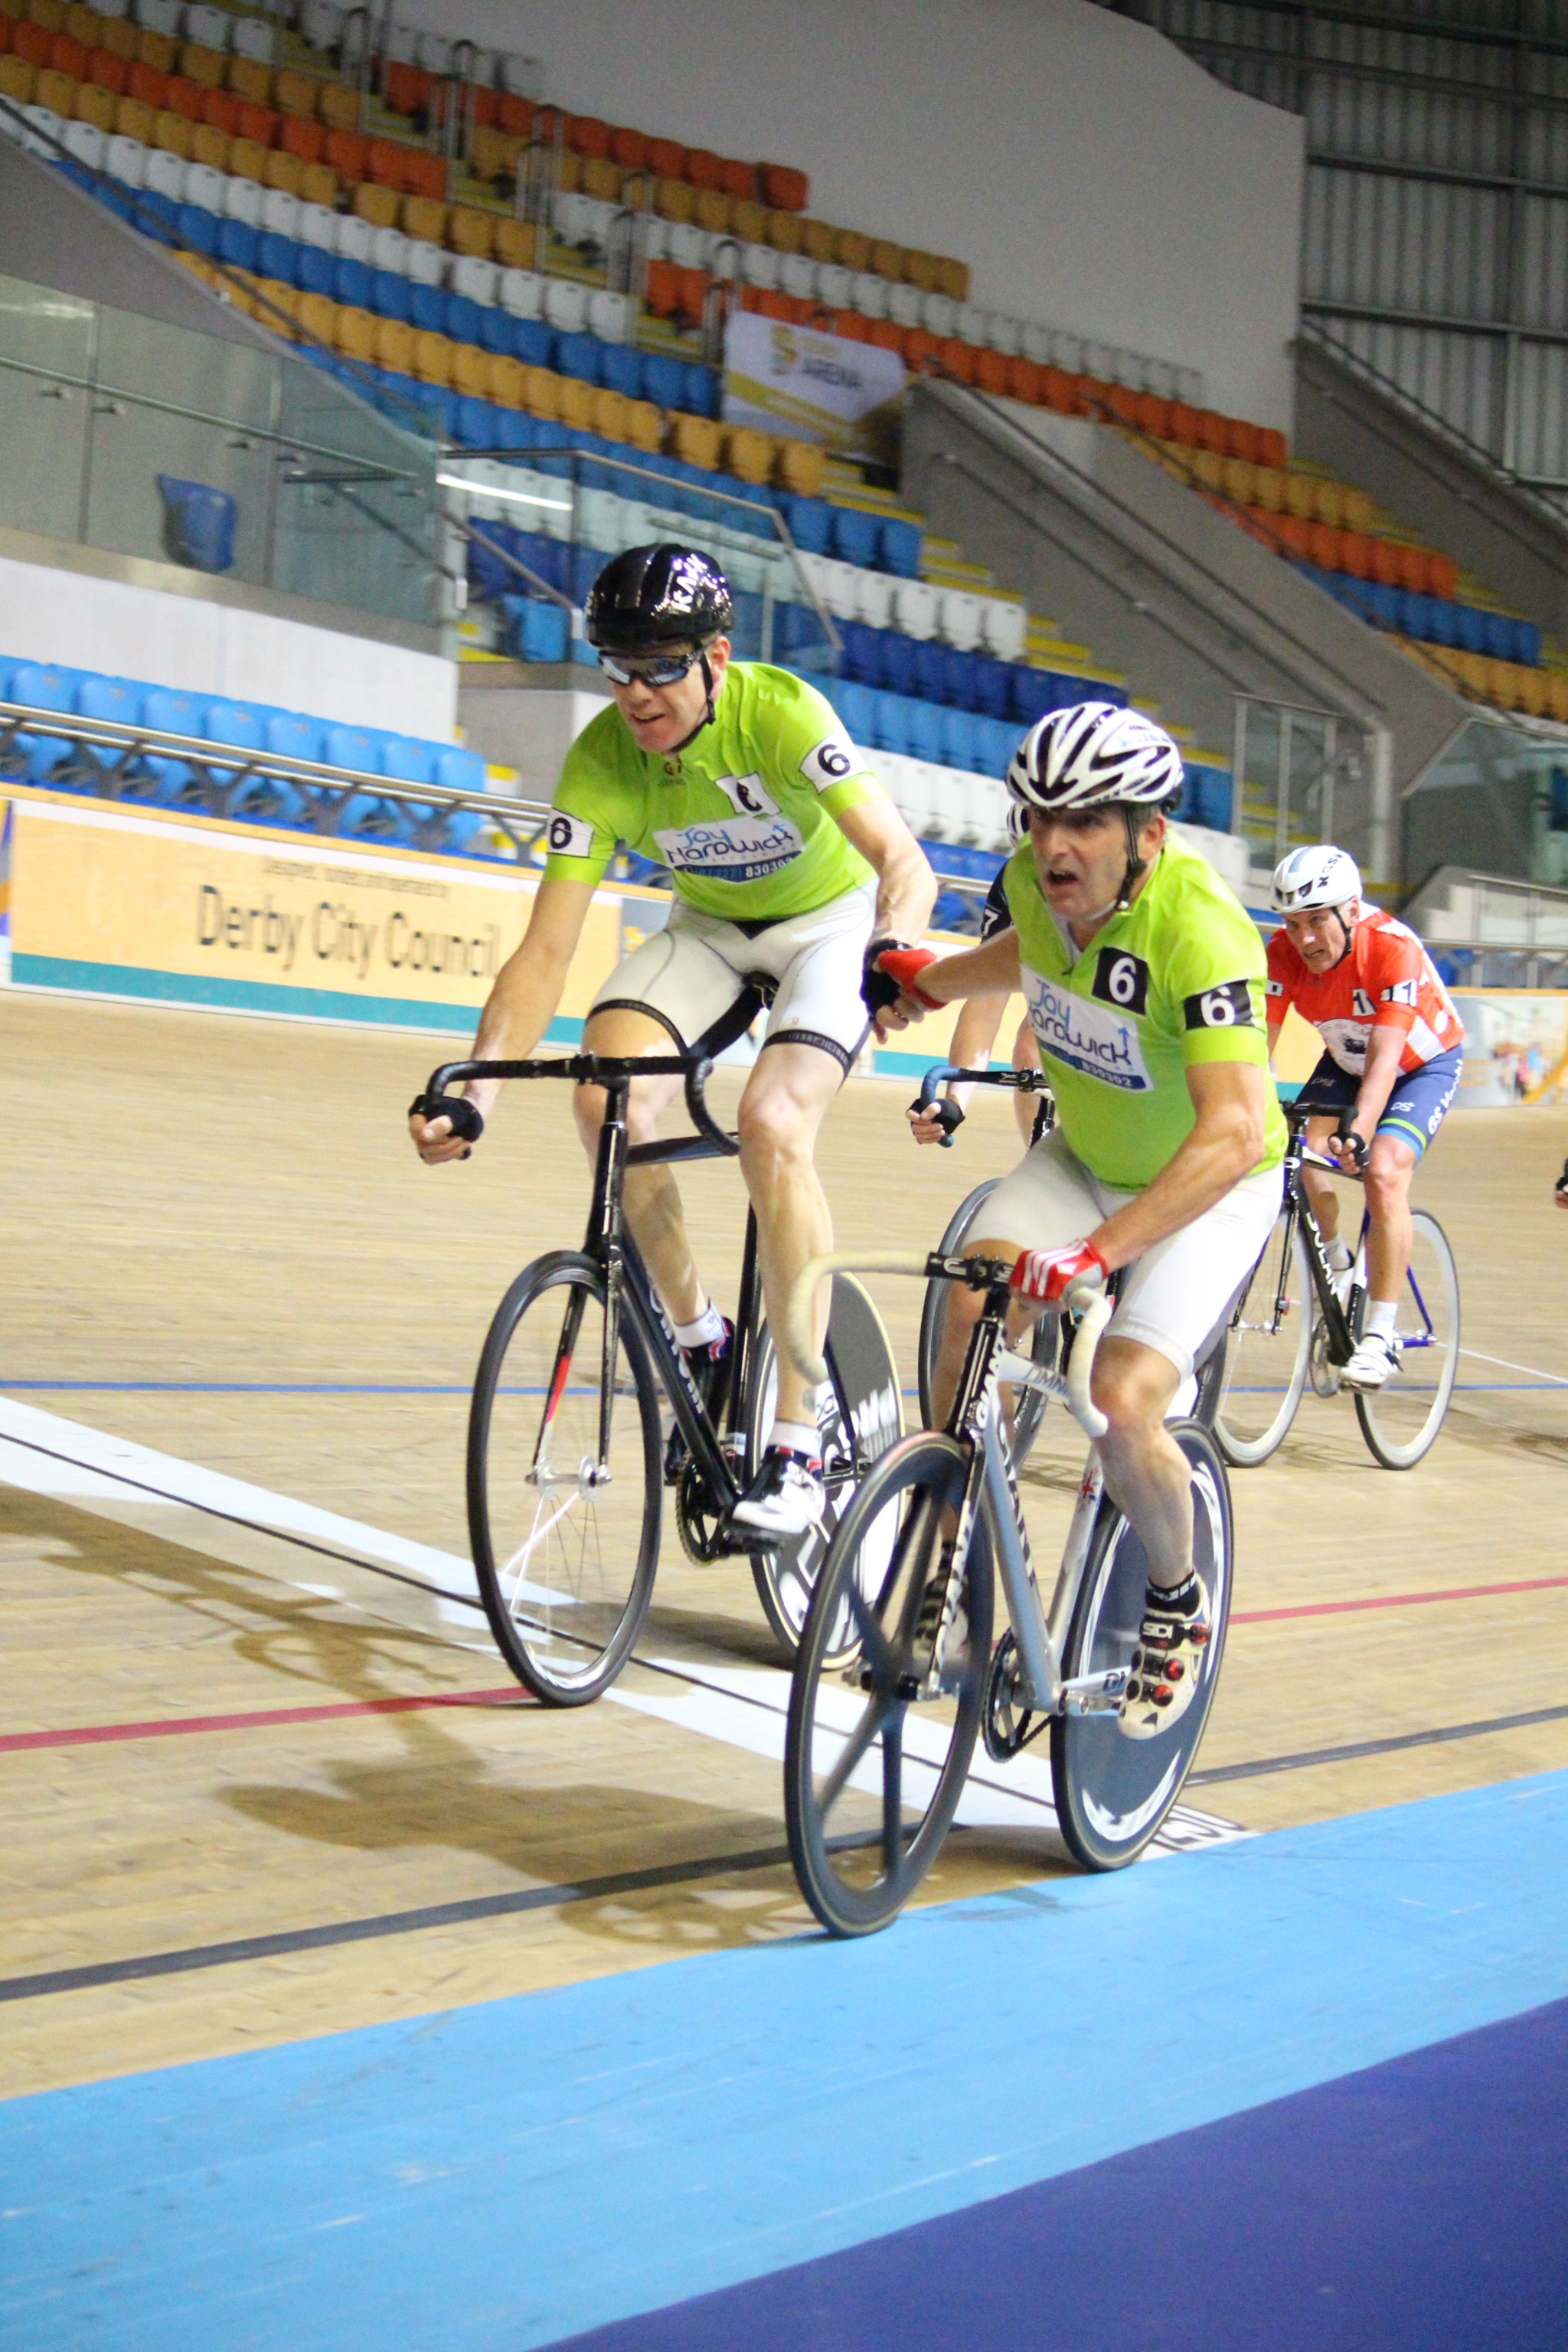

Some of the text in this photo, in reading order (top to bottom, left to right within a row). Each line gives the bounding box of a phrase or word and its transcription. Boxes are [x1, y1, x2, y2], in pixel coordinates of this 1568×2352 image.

[818, 743, 851, 776] 6
[550, 818, 573, 850] 6
[198, 884, 501, 980] Derby City Council
[982, 908, 998, 936] 7
[1109, 957, 1137, 1004] 6
[1200, 985, 1235, 1027] 6
[976, 1327, 1006, 1429] GIANT
